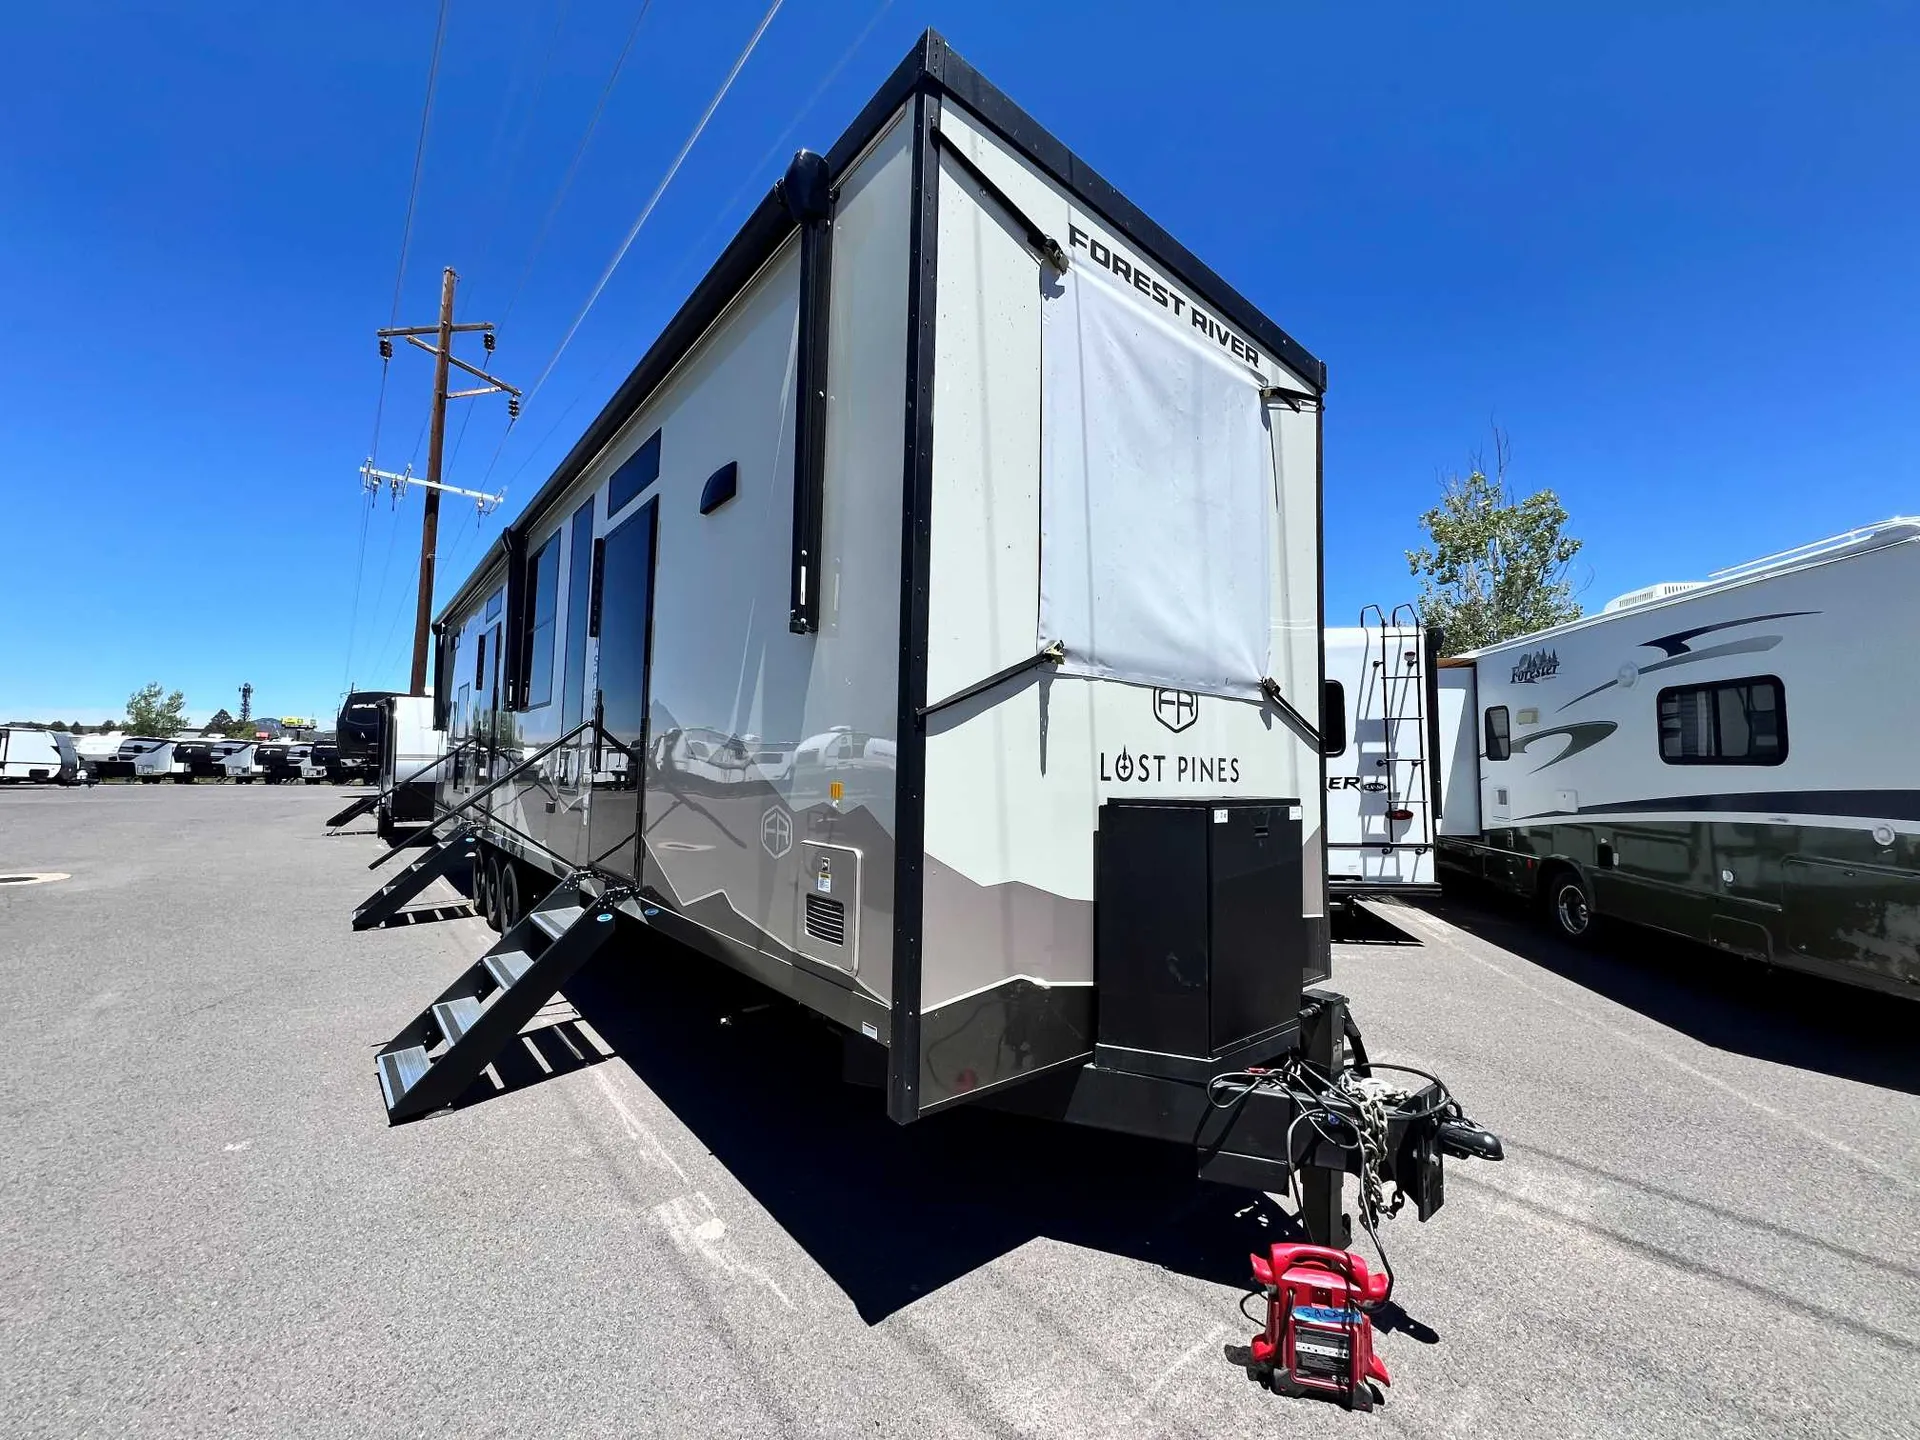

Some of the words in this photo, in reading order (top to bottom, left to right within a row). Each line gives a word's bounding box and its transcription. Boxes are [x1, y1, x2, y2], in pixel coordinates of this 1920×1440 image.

[1068, 222, 1185, 316] FOREST
[1191, 306, 1259, 368] RIVER
[1510, 664, 1558, 684] Forester
[1101, 745, 1165, 782] LOST
[1178, 756, 1239, 783] PINES
[1326, 776, 1361, 793] ER
